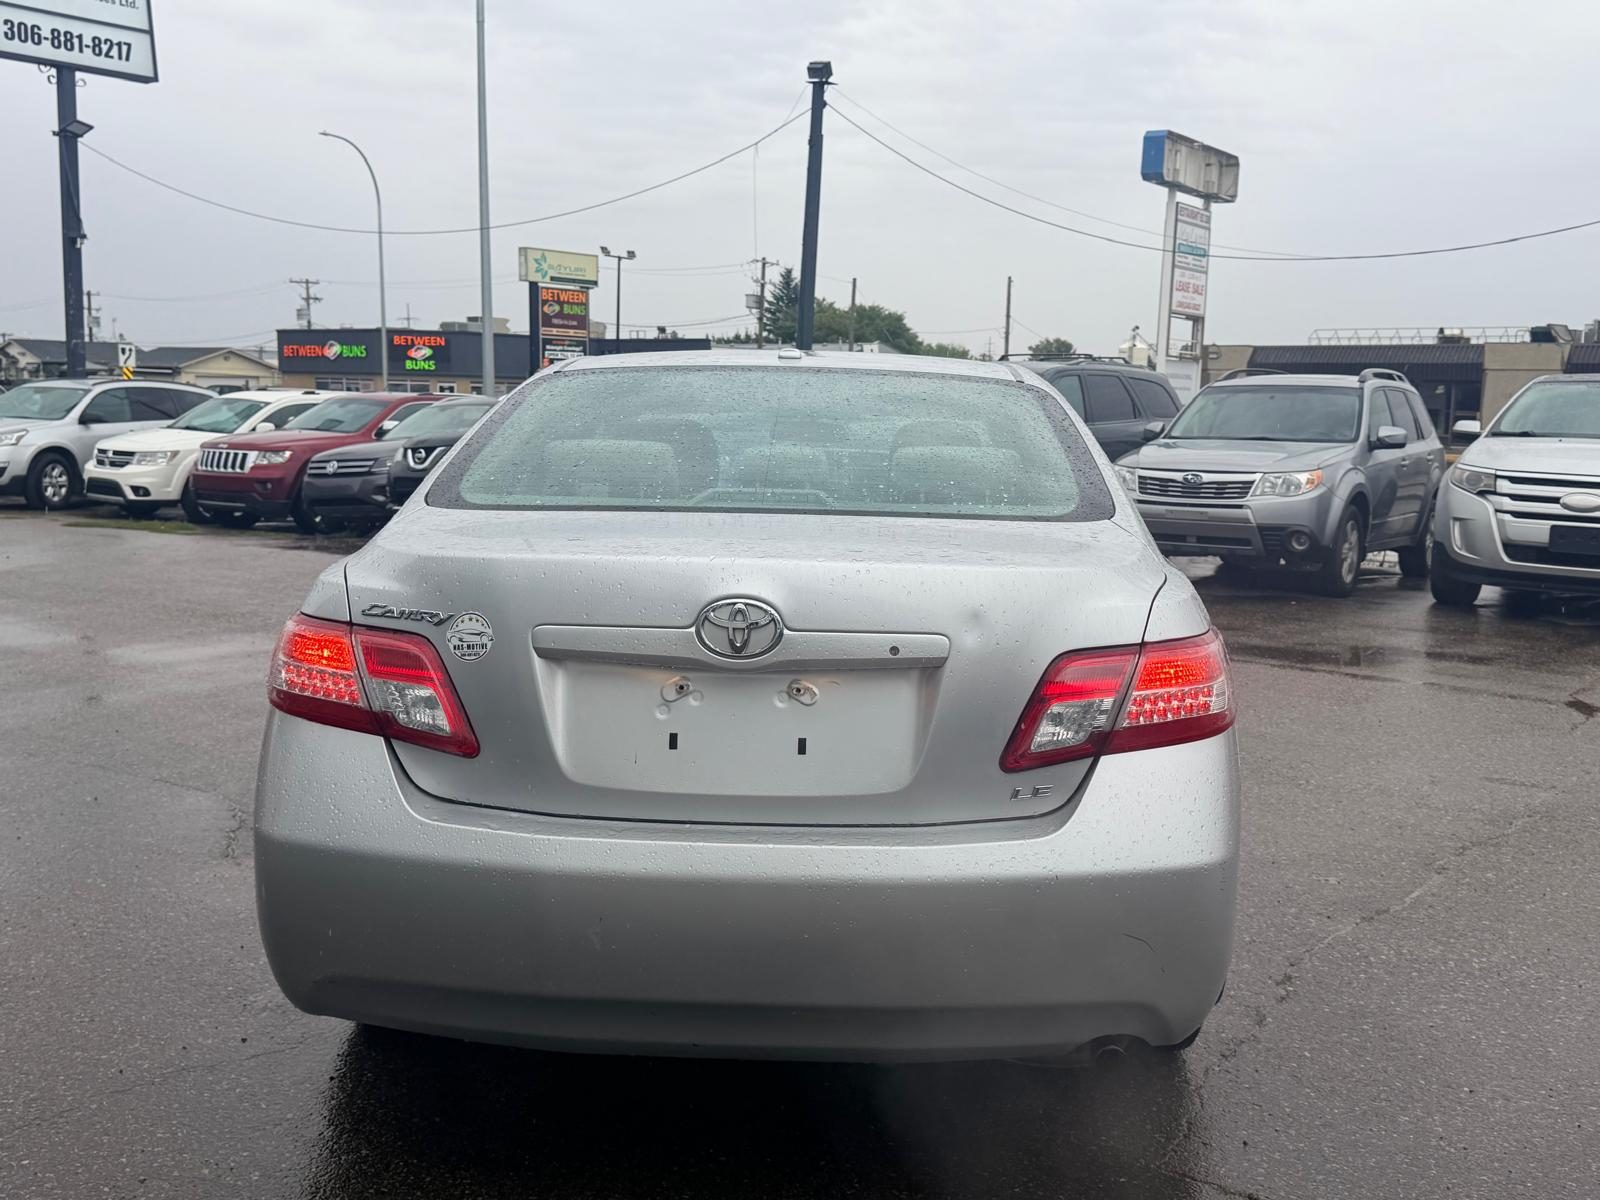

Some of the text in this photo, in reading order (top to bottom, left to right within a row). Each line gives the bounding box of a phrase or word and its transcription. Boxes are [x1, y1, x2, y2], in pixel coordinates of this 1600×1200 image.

[3, 18, 132, 62] 306-881-8217
[542, 289, 585, 303] BETWEEN
[563, 304, 586, 315] BUNS
[393, 335, 445, 346] BETWEEN
[283, 345, 367, 357] BETWEEN BUNS
[405, 360, 436, 370] BUNS
[361, 602, 456, 626] CAMRY
[1010, 784, 1054, 801] LE
